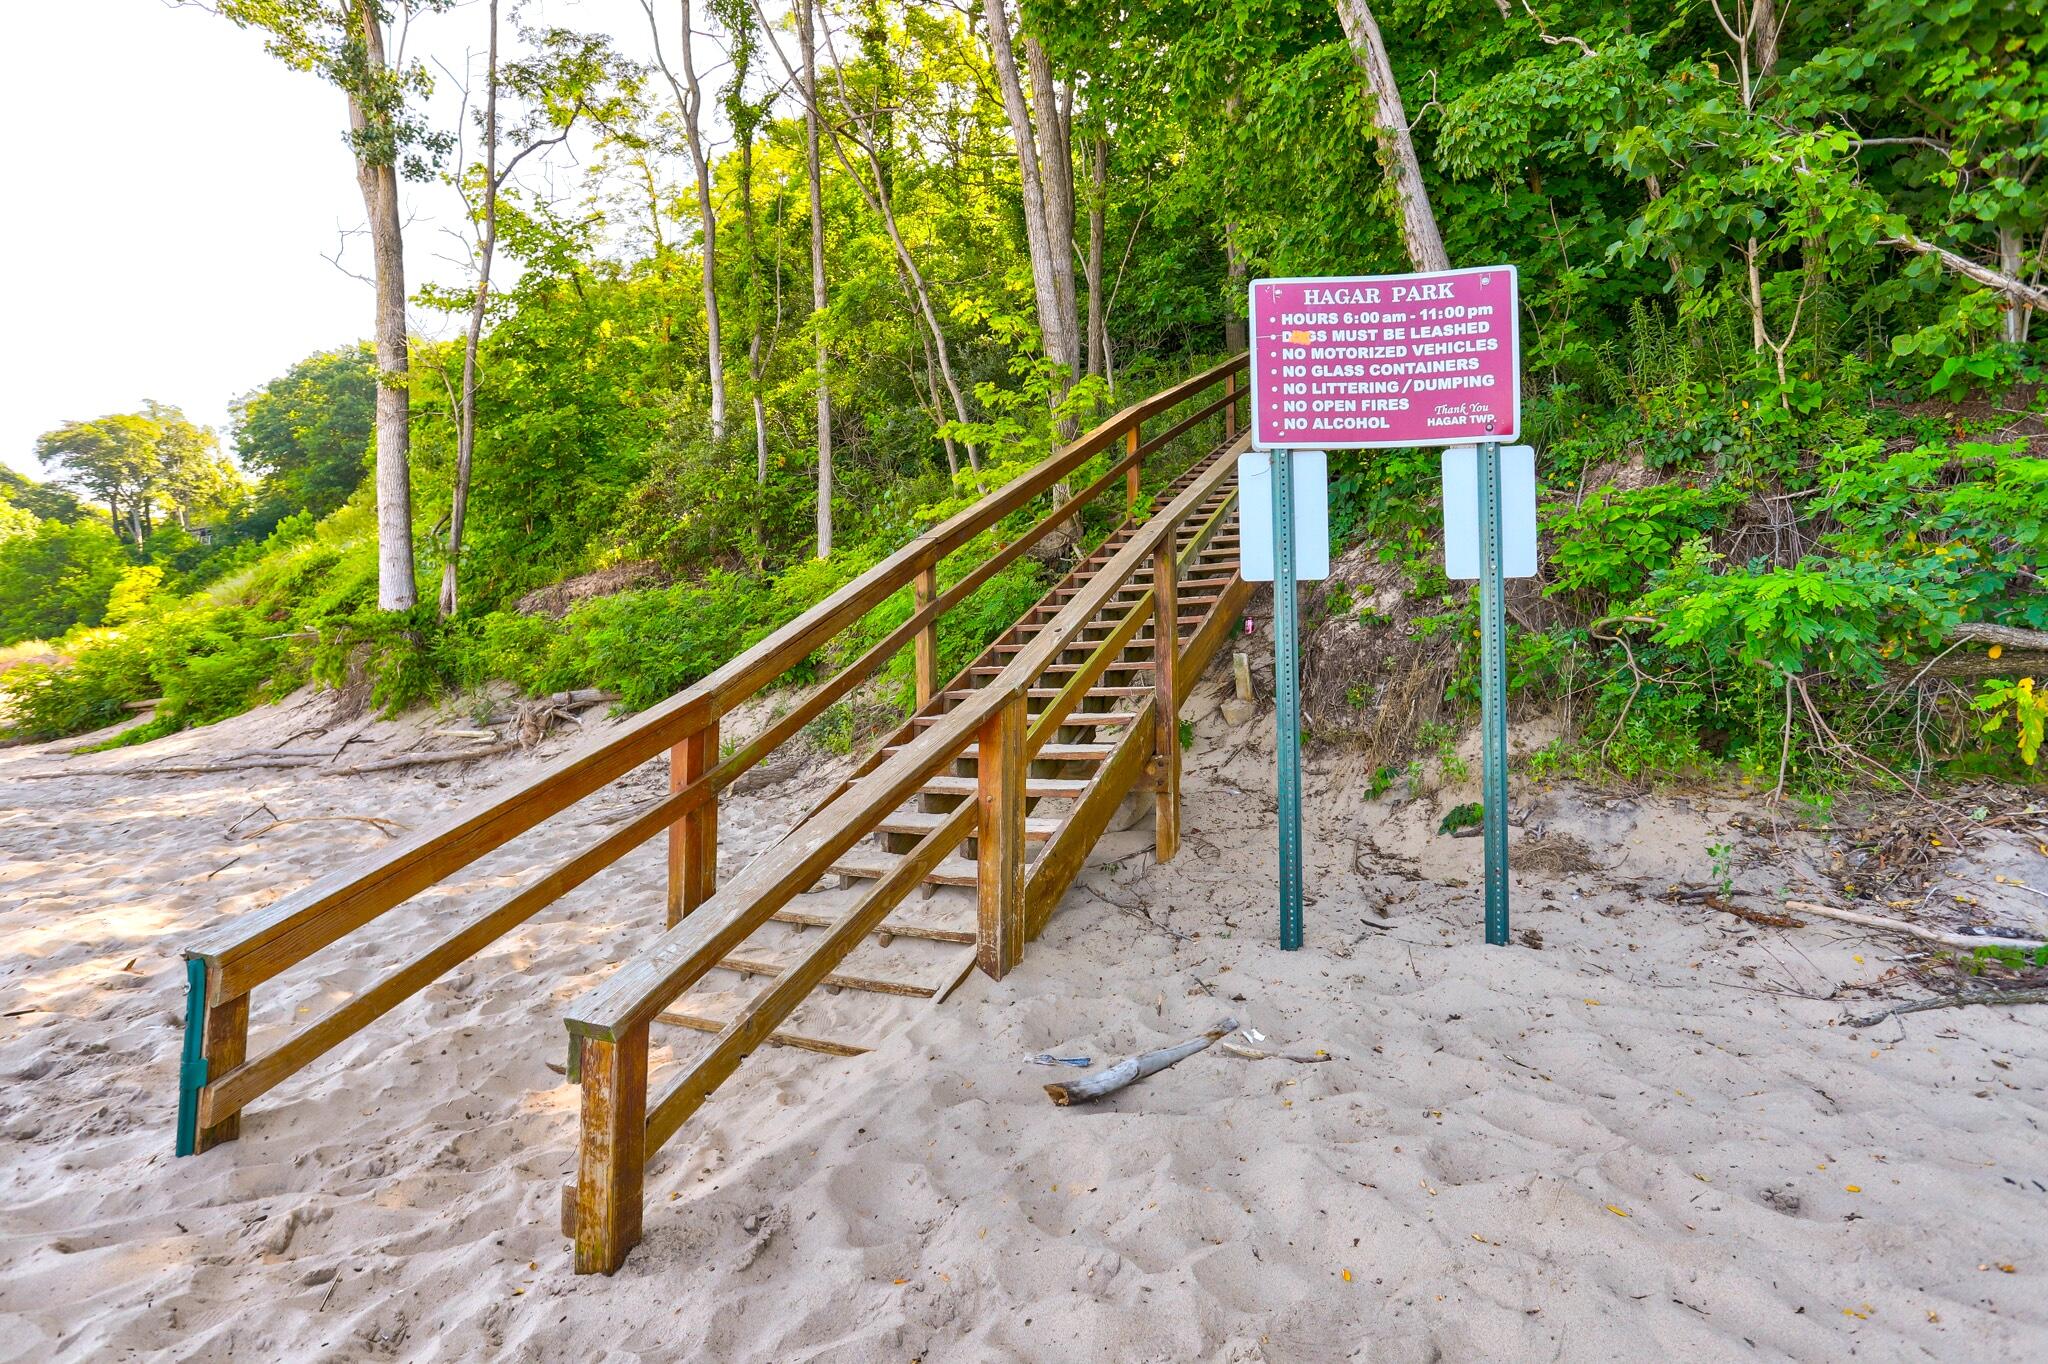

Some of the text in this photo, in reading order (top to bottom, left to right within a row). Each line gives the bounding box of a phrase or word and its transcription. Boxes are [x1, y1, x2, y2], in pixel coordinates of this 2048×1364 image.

[1304, 283, 1455, 305] HAGAR PARK
[1282, 313, 1338, 325] HOURS
[1343, 311, 1379, 324] 6:00
[1382, 311, 1406, 322] am
[1420, 306, 1465, 320] 11:00
[1467, 305, 1493, 319] pm
[1282, 322, 1490, 343] DGS MUST BE LEASHED
[1283, 338, 1498, 360] NO MOTORIZED VEHICLES
[1283, 358, 1479, 377] NO GLASS CONTAINERS
[1284, 383, 1307, 394] NO
[1284, 398, 1409, 412] NO OPEN FIRES
[1435, 402, 1489, 415] Thank You
[1284, 416, 1390, 430] NO ALCOHOL
[1428, 415, 1466, 426] HAGAR
